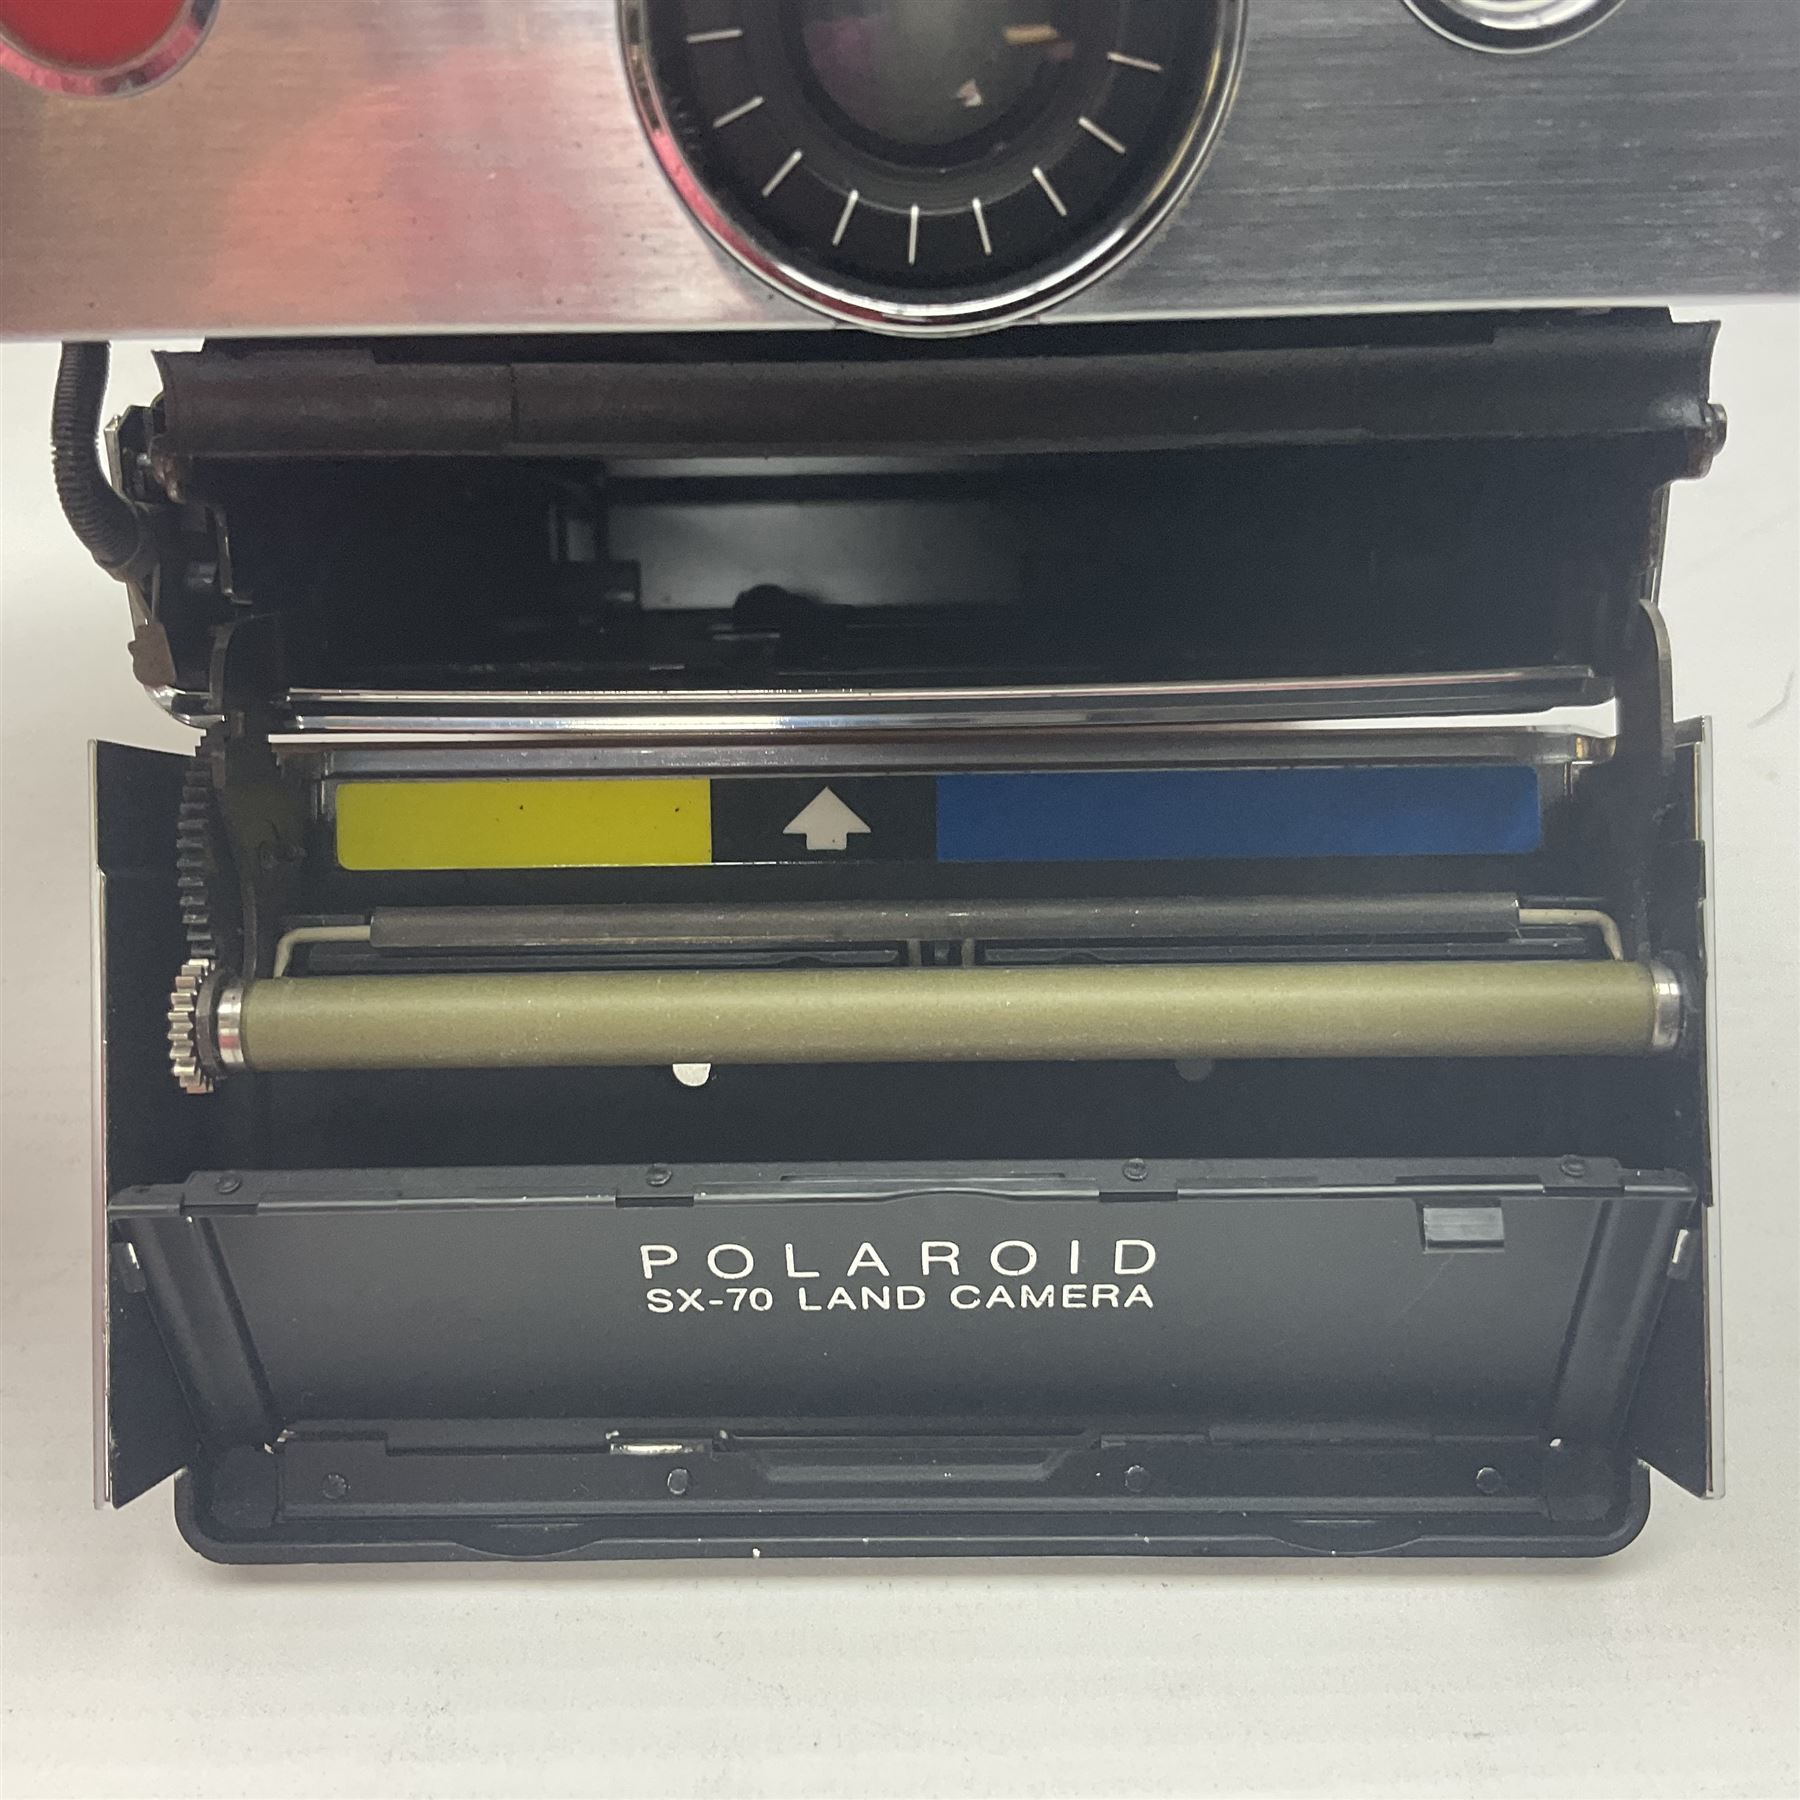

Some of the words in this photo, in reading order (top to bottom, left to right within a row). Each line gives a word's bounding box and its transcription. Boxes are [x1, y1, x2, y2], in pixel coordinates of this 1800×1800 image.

[639, 1239, 1158, 1281] POLAROID
[646, 1287, 775, 1314] SX-70
[798, 1285, 926, 1312] LAND
[950, 1283, 1154, 1310] CAMERA
